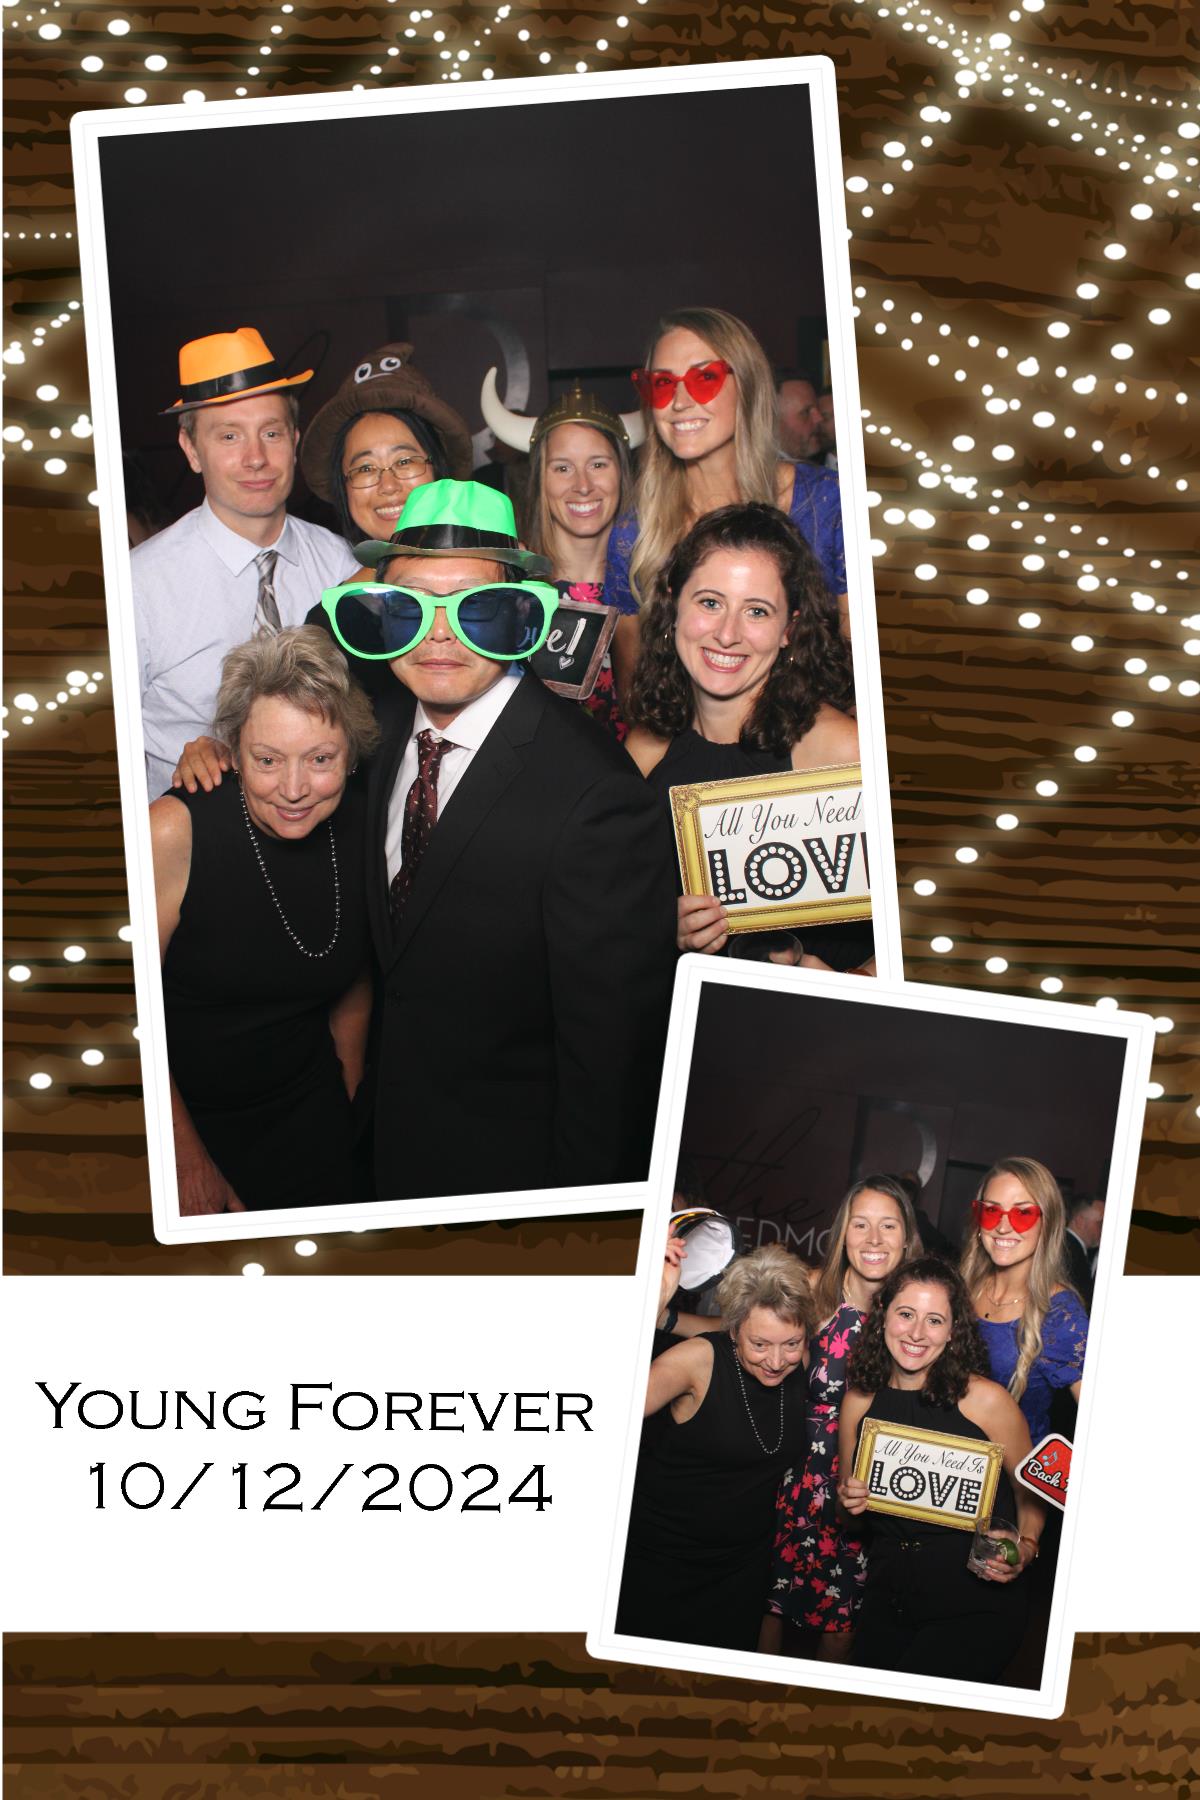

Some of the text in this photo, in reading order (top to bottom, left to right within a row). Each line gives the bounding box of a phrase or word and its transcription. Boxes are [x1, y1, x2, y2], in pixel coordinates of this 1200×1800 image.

[704, 792, 862, 844] All You Need
[708, 832, 870, 906] LOV
[875, 1439, 902, 1456] All
[899, 1443, 929, 1464] You
[932, 1450, 965, 1470] Need
[1027, 1458, 1062, 1487] Back
[869, 1460, 982, 1514] LOVE
